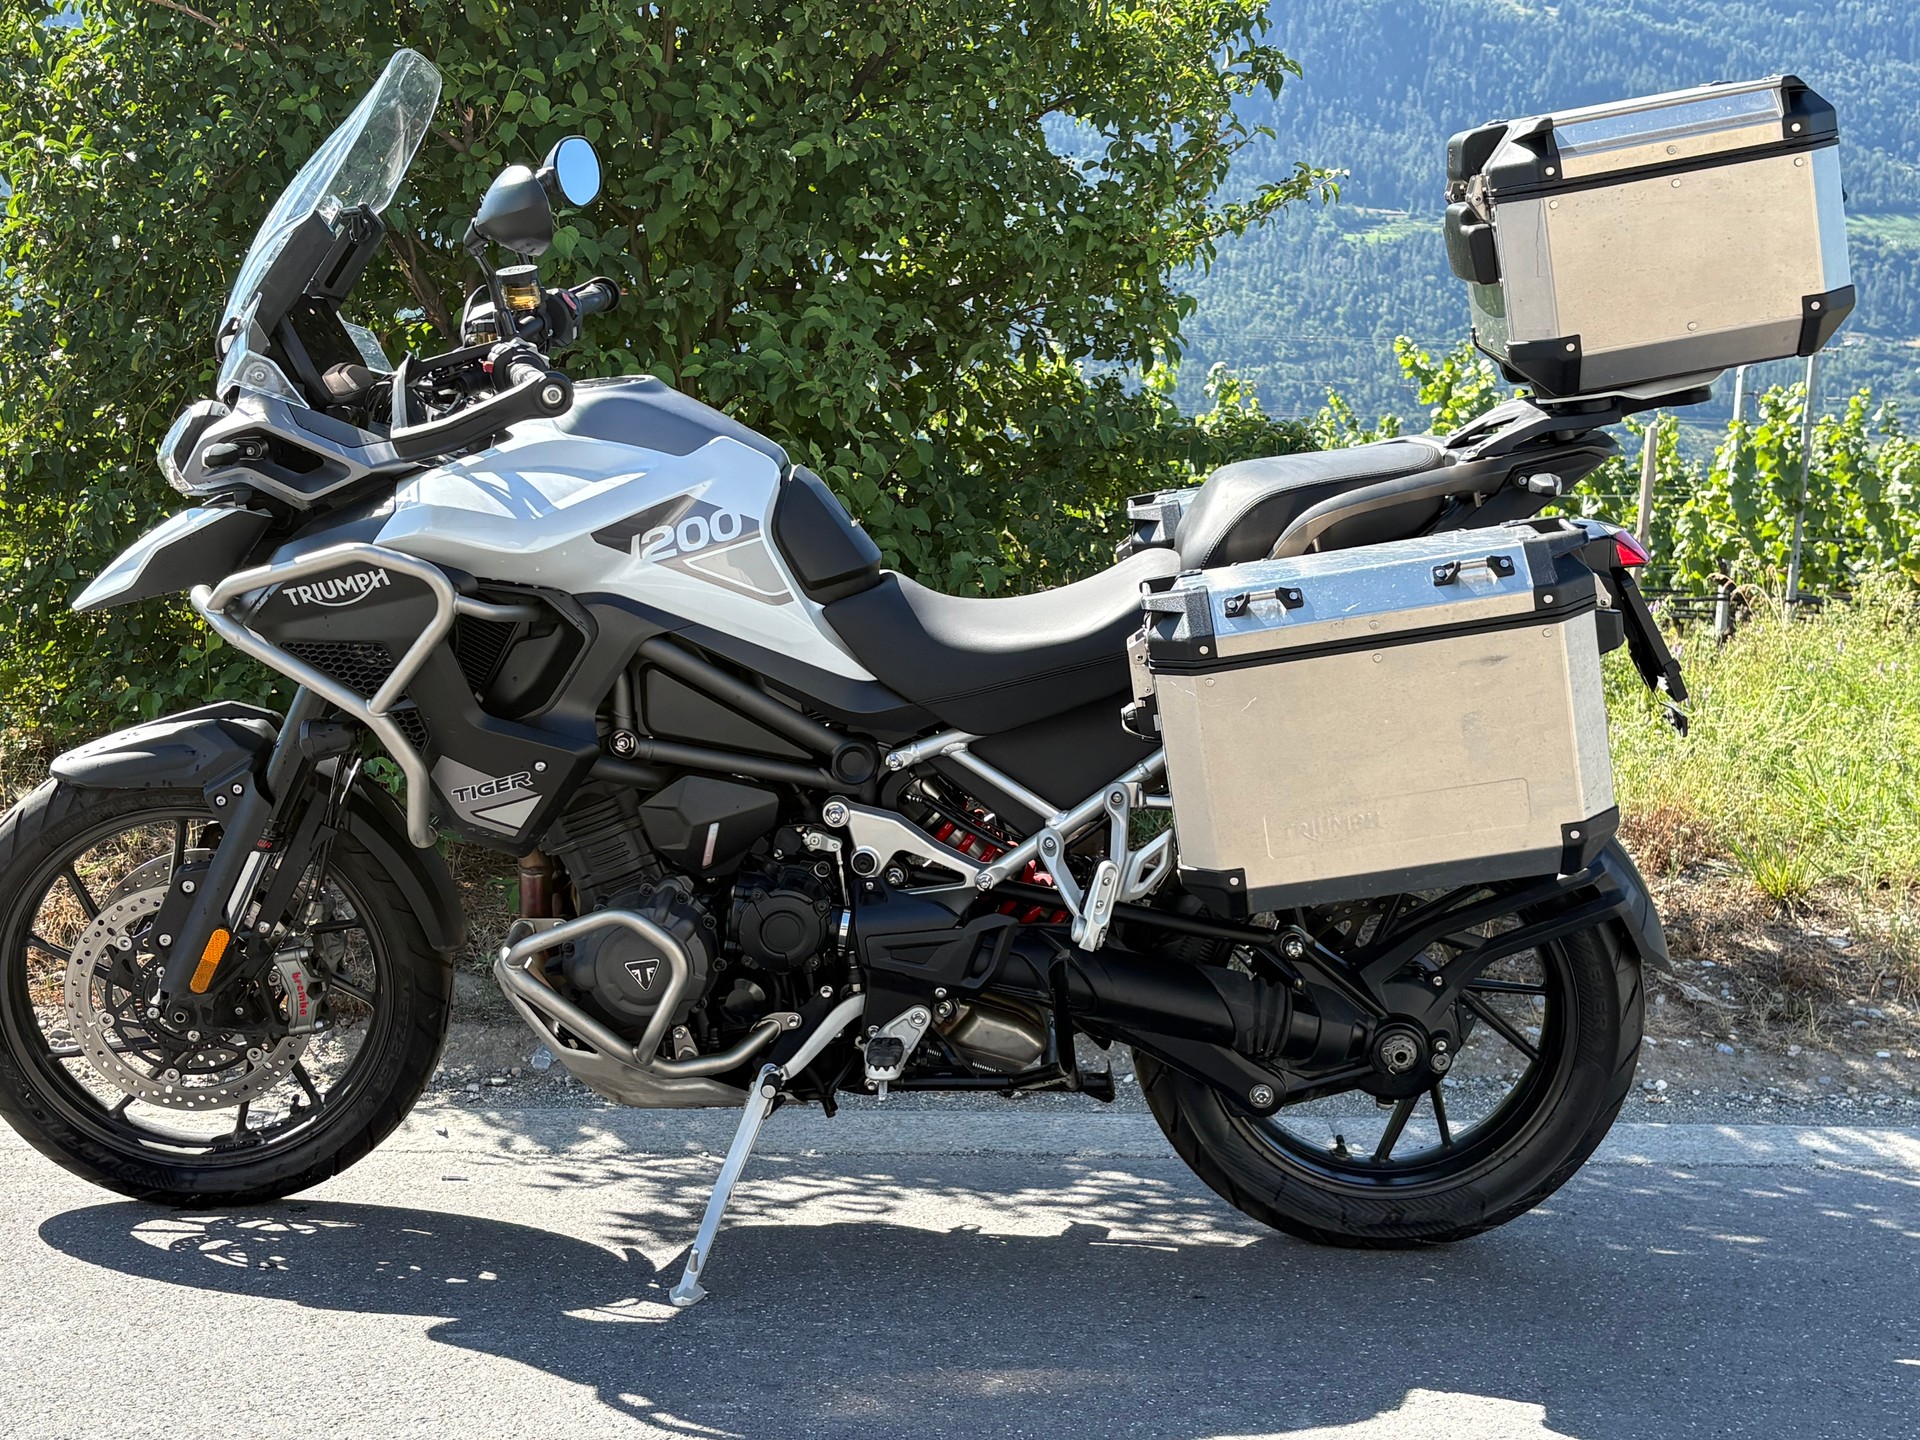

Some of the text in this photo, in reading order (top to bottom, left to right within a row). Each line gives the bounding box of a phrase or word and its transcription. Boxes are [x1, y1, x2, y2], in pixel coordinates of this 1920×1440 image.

[630, 508, 742, 561] 1200
[282, 568, 391, 607] TRIUMPH
[451, 771, 534, 803] TIGER
[292, 971, 309, 1017] brembo
